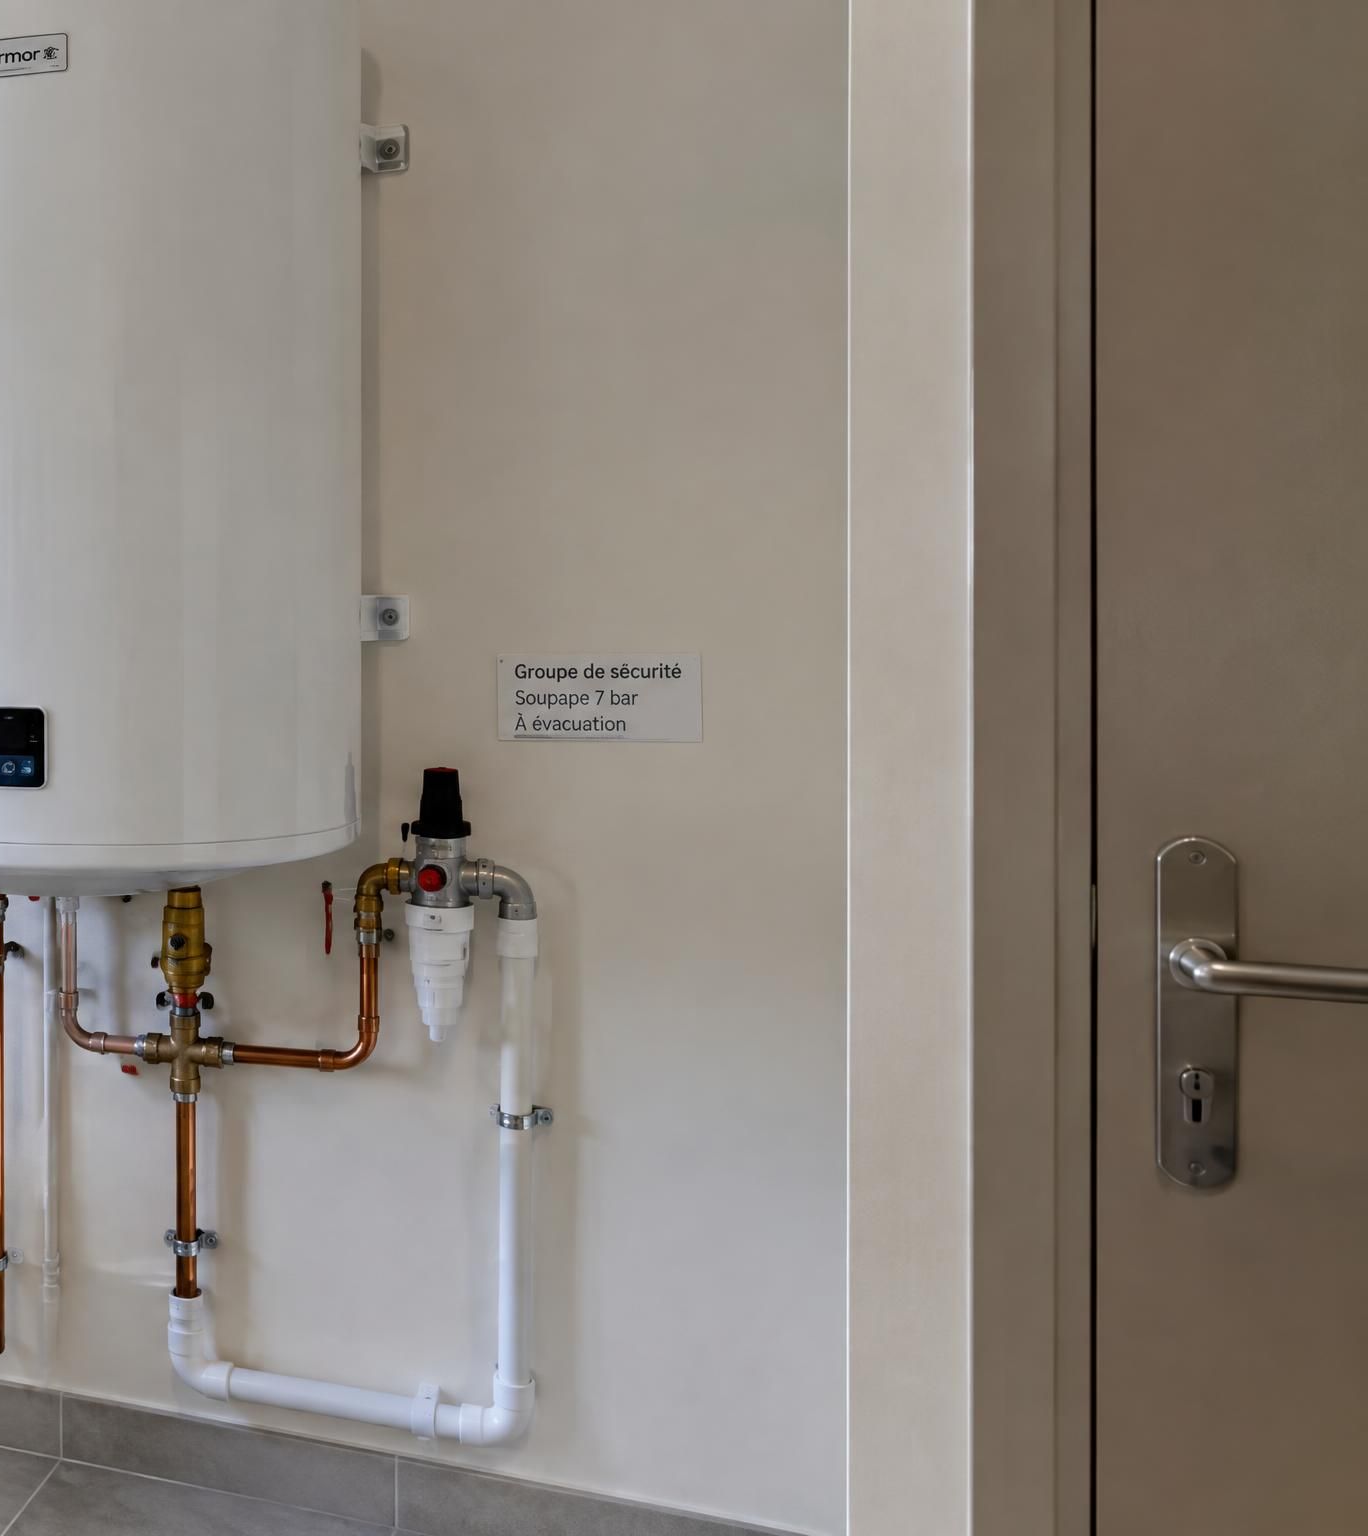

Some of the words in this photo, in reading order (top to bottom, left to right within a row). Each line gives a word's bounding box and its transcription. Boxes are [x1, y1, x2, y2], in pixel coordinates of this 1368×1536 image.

[514, 663, 578, 683] Groupe
[583, 663, 605, 679] de
[515, 690, 590, 709] Soupape
[595, 690, 605, 706] 7
[610, 690, 639, 706] bar
[515, 713, 527, 732] À
[532, 715, 627, 732] évacuation
